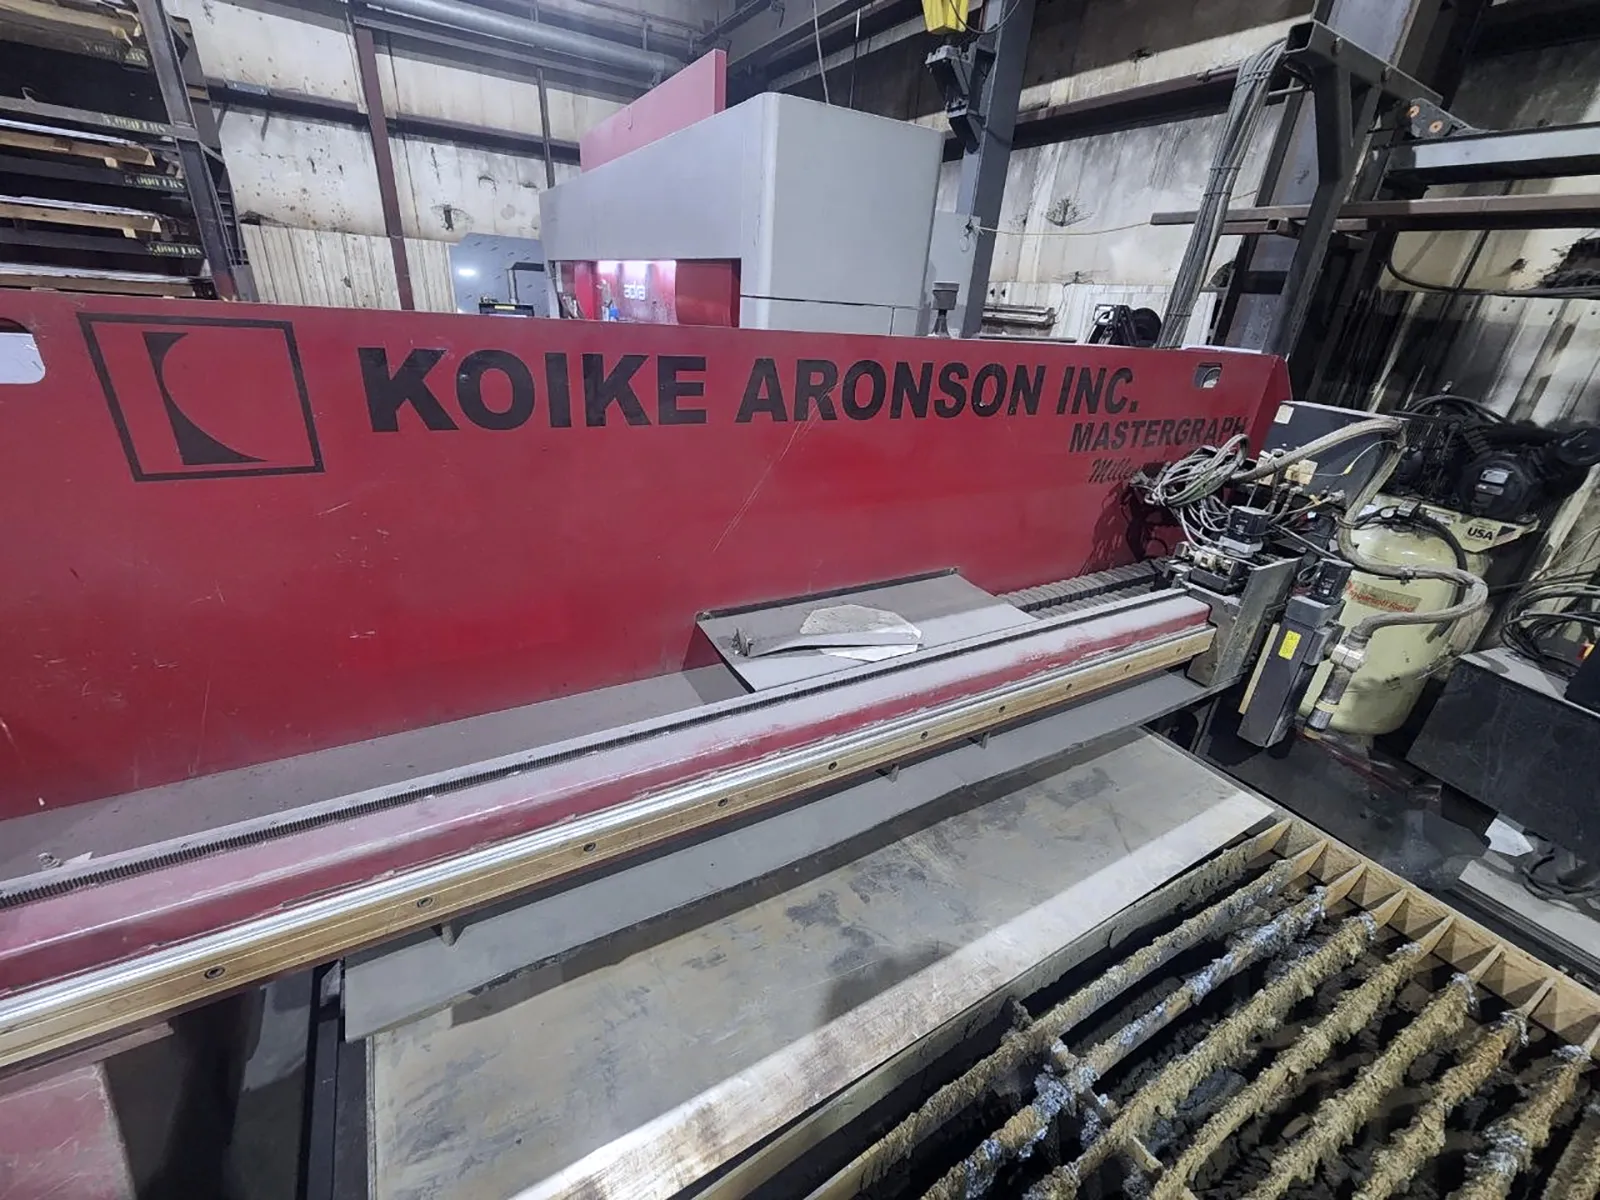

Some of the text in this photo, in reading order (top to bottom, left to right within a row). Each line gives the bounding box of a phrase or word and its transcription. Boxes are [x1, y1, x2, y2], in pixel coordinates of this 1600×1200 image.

[357, 347, 1139, 432] KOIKE ARONSON INC.
[1467, 527, 1493, 541] USA
